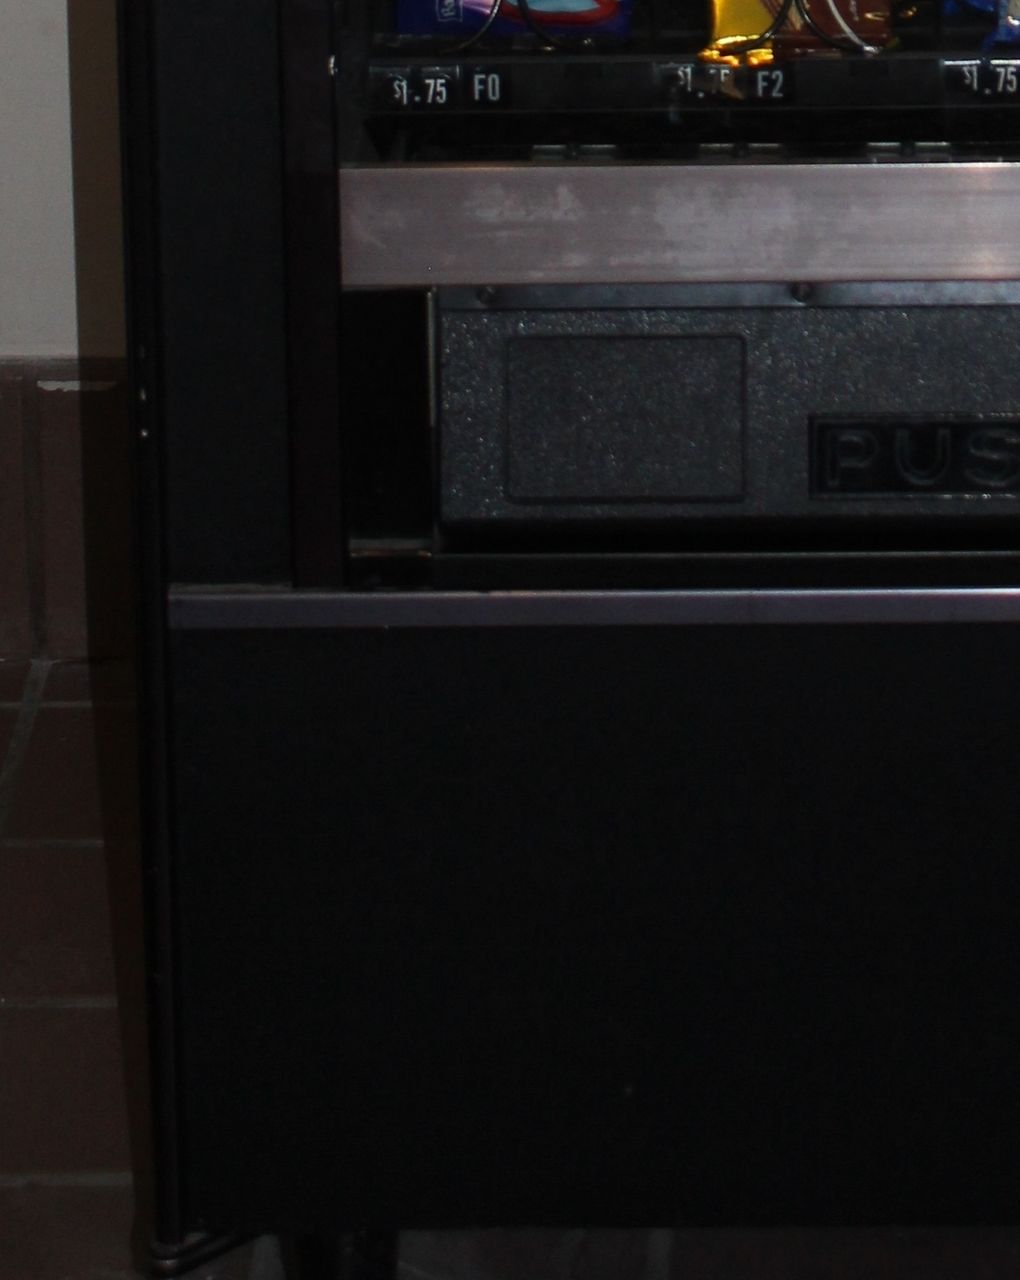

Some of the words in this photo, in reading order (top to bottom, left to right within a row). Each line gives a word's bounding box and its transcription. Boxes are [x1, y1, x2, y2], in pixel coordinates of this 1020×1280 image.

[392, 78, 447, 105] $1.75
[473, 75, 500, 102] F0
[757, 71, 784, 98] F2
[963, 65, 1017, 95] $1.75
